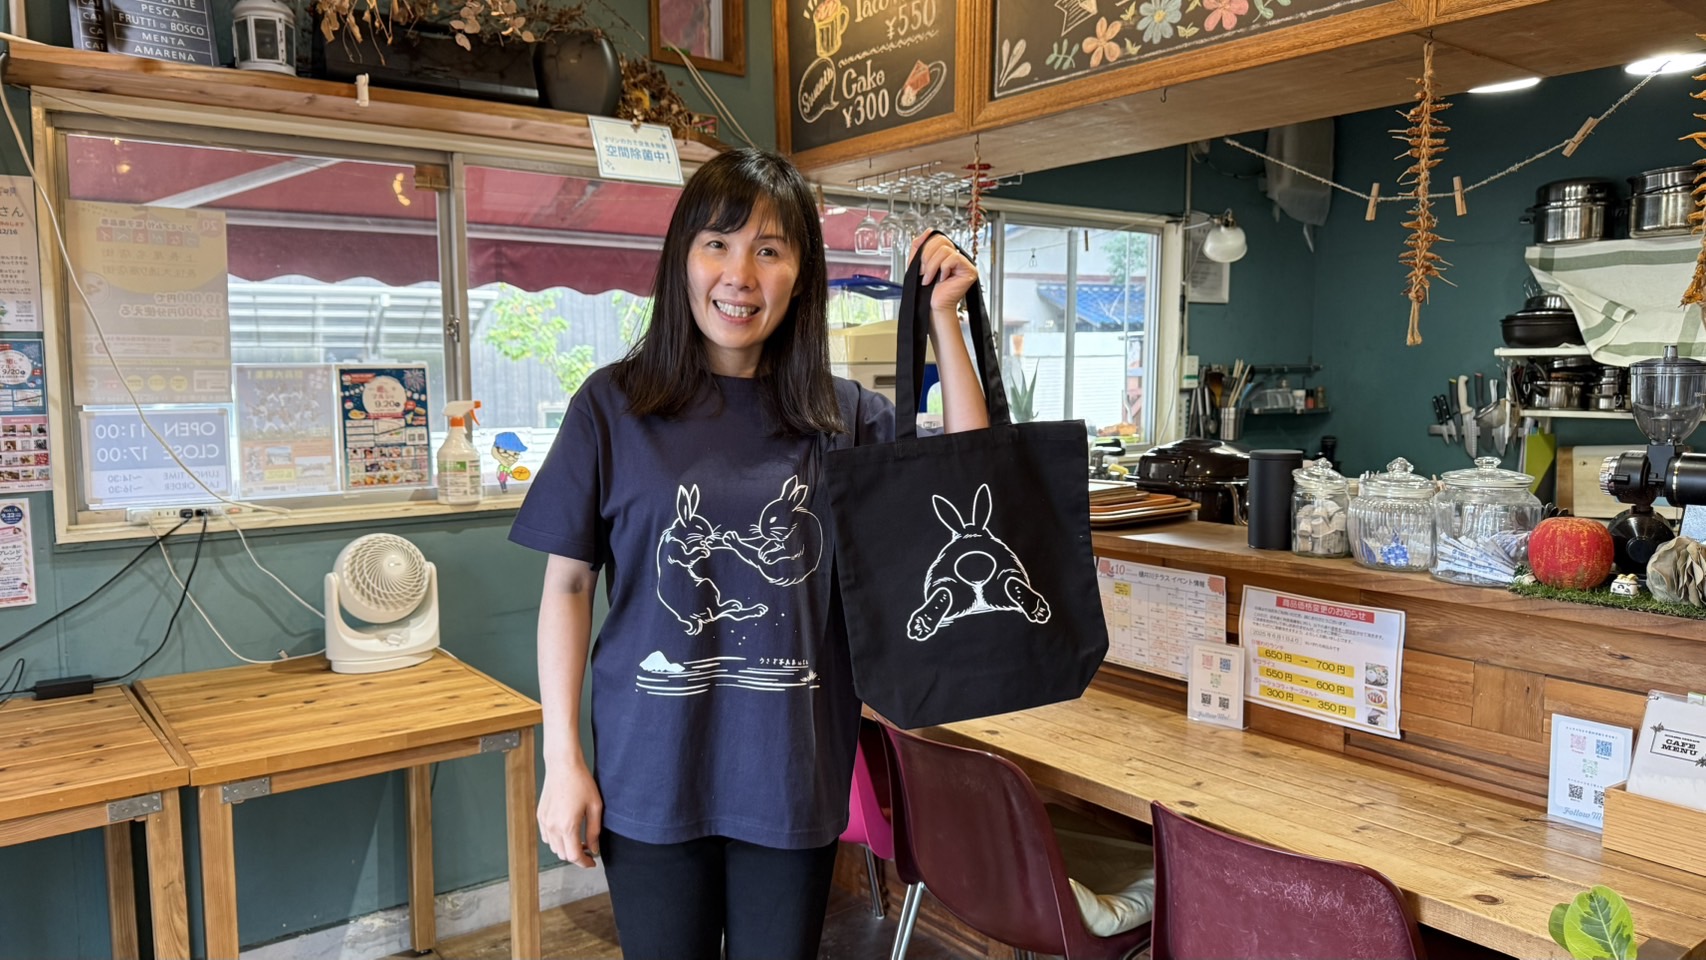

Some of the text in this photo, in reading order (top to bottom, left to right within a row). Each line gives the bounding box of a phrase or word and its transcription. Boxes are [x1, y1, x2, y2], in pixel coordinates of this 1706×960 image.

[141, 3, 180, 19] PESCA
[118, 12, 156, 27] FRUTTI
[170, 22, 205, 36] BOSCO
[885, 0, 937, 40] ¥550
[142, 32, 186, 46] MENTA
[134, 45, 196, 62] AMARENA
[842, 88, 890, 129] ¥300
[1115, 564, 1126, 575] 10
[1282, 599, 1367, 620] 商品価格変更のお知らせ
[1660, 743, 1698, 756] MENU
[1665, 738, 1696, 750] CAFE
[1562, 807, 1604, 821] Follow M
